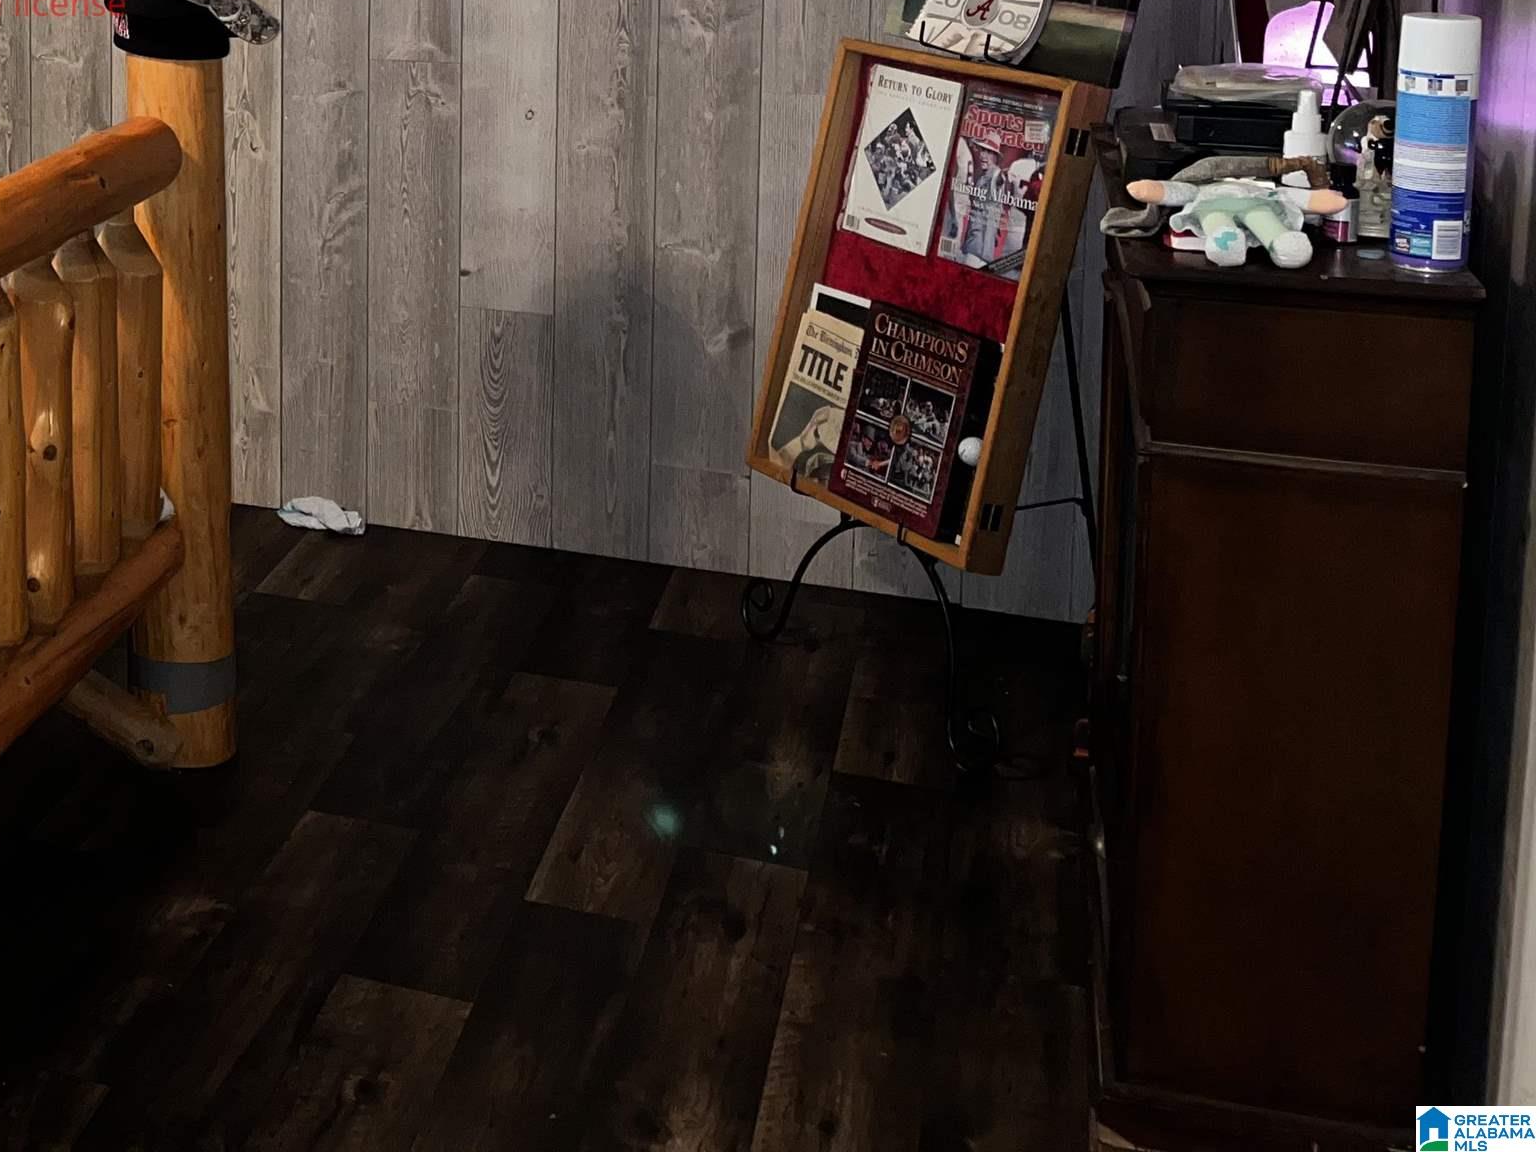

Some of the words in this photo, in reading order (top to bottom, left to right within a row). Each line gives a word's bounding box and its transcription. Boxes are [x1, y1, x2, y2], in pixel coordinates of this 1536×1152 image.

[998, 10, 1031, 30] 08
[967, 104, 1024, 132] Sports
[798, 344, 849, 393] TITLE
